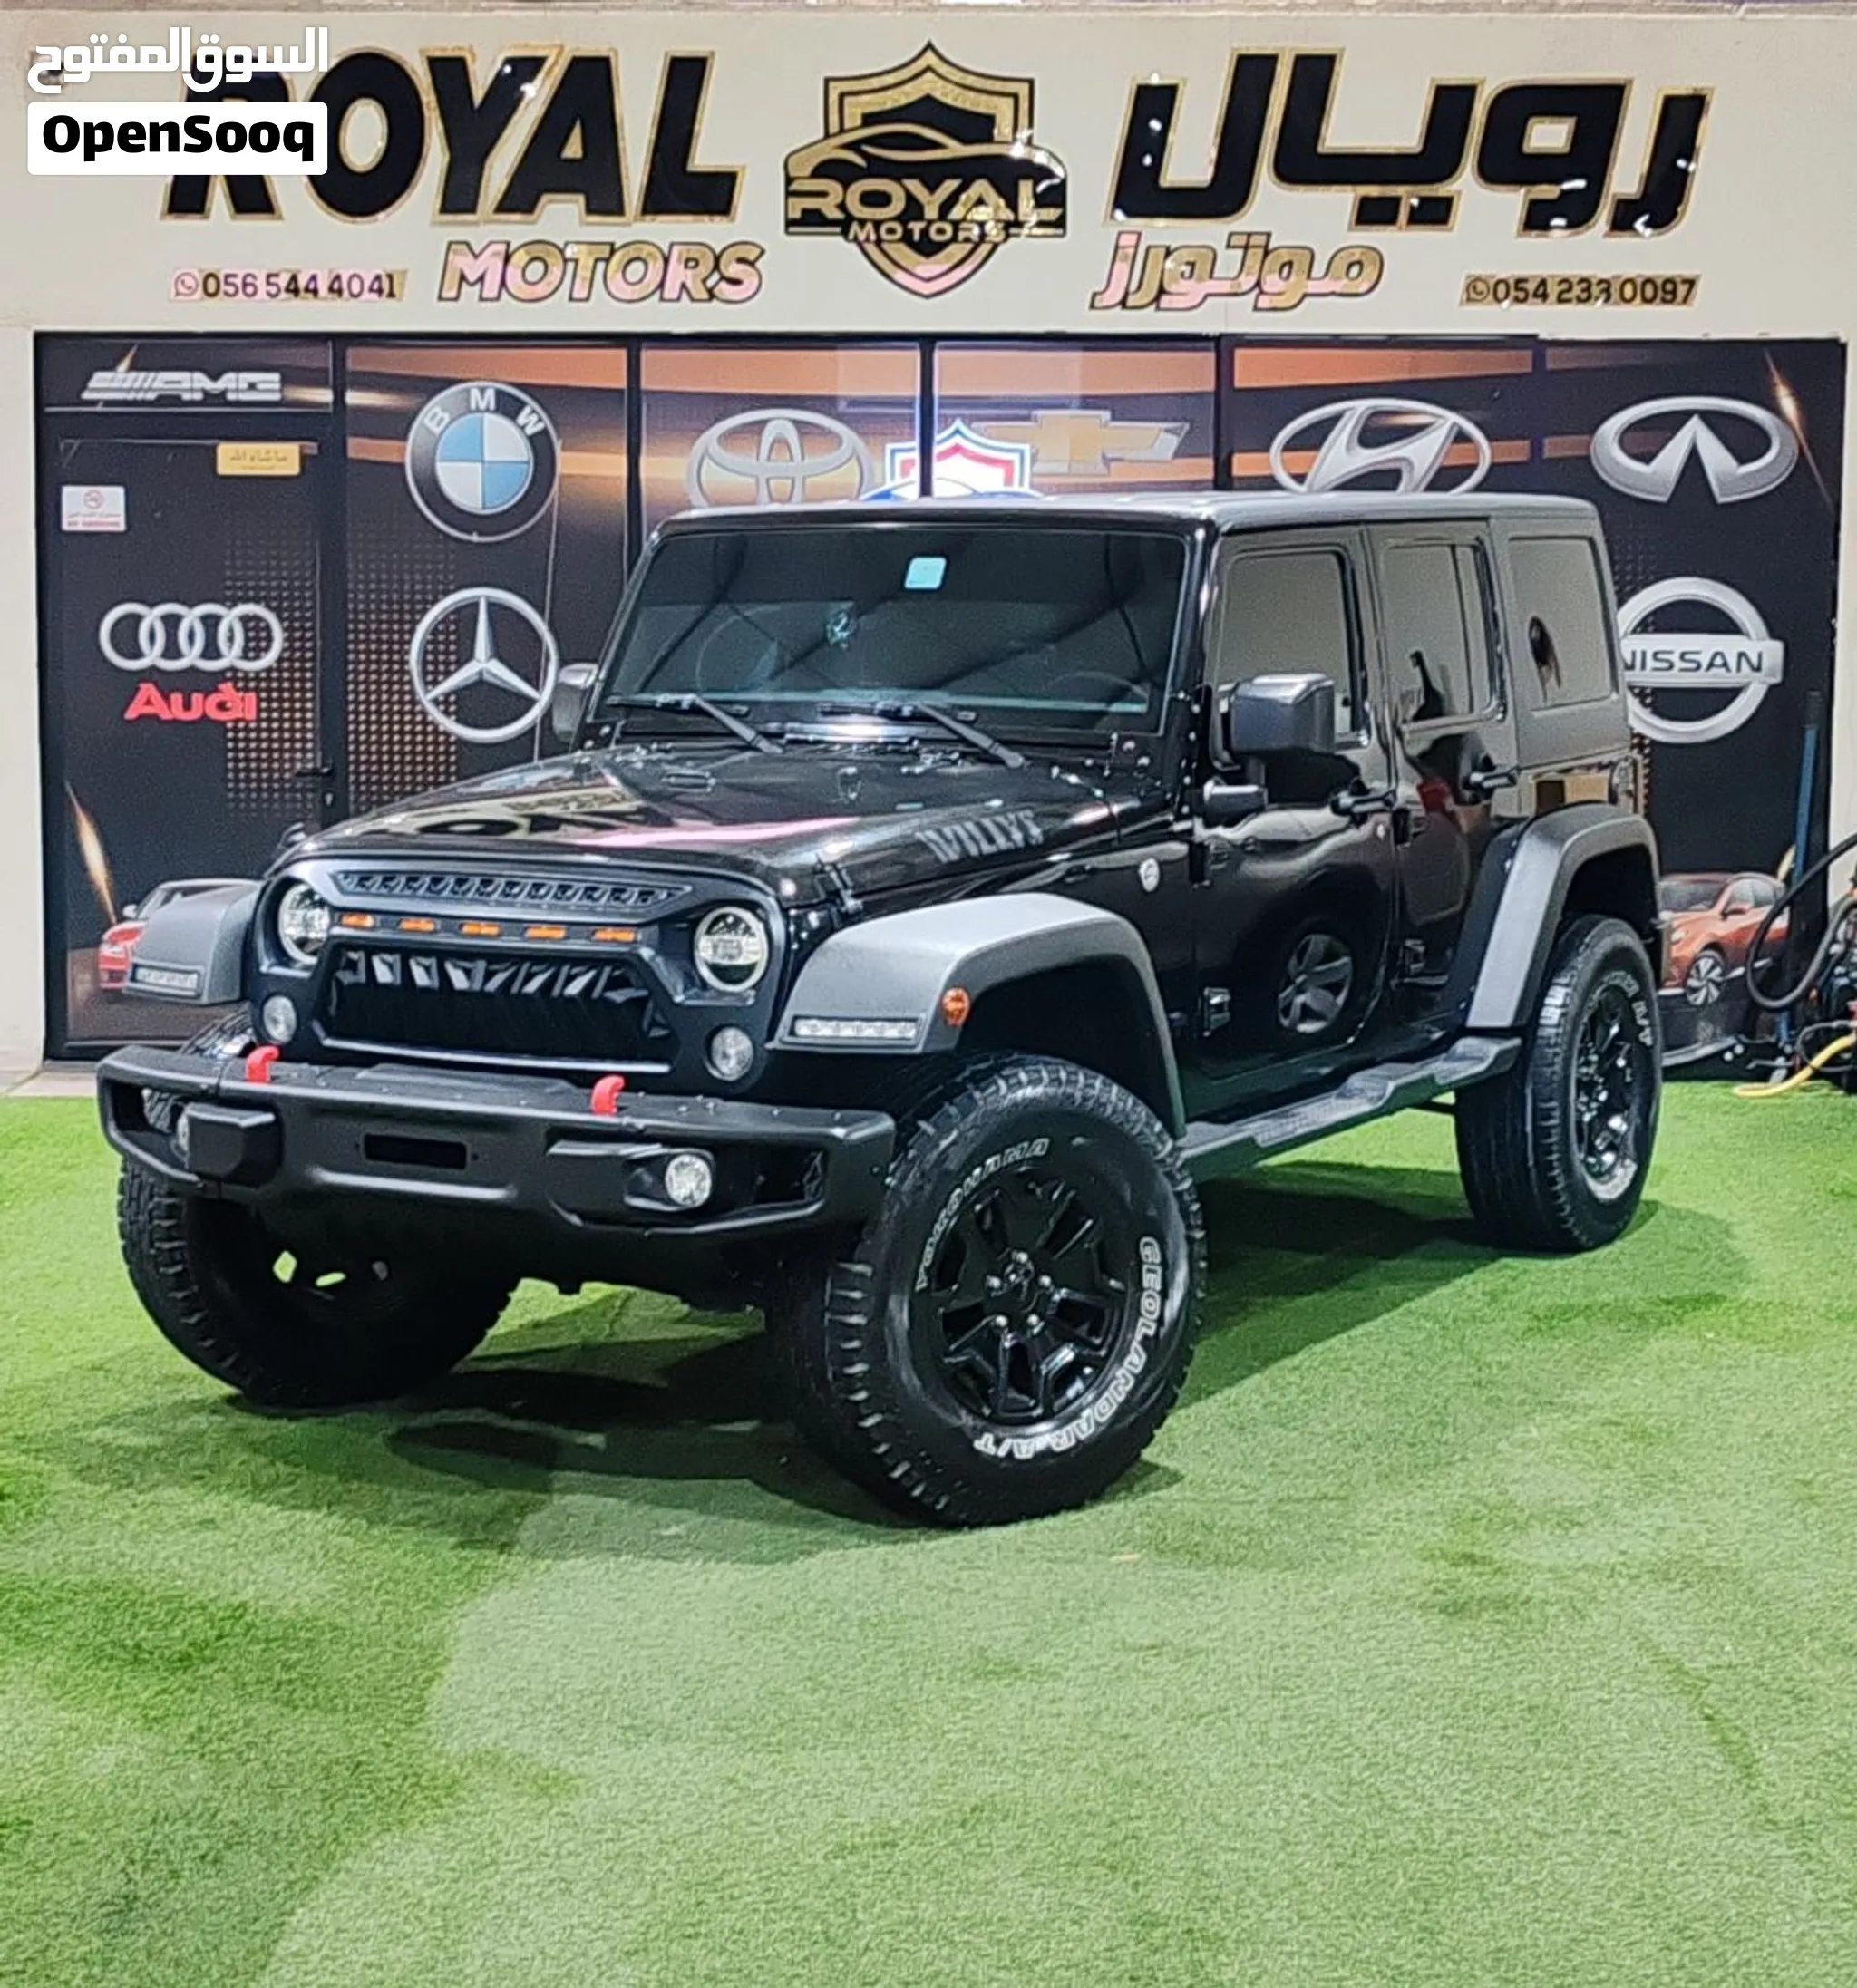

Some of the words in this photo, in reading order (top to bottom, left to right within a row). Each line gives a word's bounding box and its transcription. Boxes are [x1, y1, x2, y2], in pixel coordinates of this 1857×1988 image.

[1102, 45, 1716, 238] رويال
[787, 178, 1064, 220] ROYAL
[848, 221, 1006, 242] MOTORS
[201, 272, 258, 298] 056
[265, 273, 319, 298] 544
[327, 273, 397, 298] 4041
[438, 240, 764, 304] MOTORS
[1089, 231, 1385, 312] موتورز
[1492, 277, 1550, 305] 054
[1619, 278, 1697, 305] 0097
[141, 371, 282, 402] AMG
[423, 387, 545, 437] BMW
[123, 682, 257, 721] Audi
[1050, 1236, 1163, 1453] GEOLANDAR
[973, 1431, 1039, 1460] A/T
